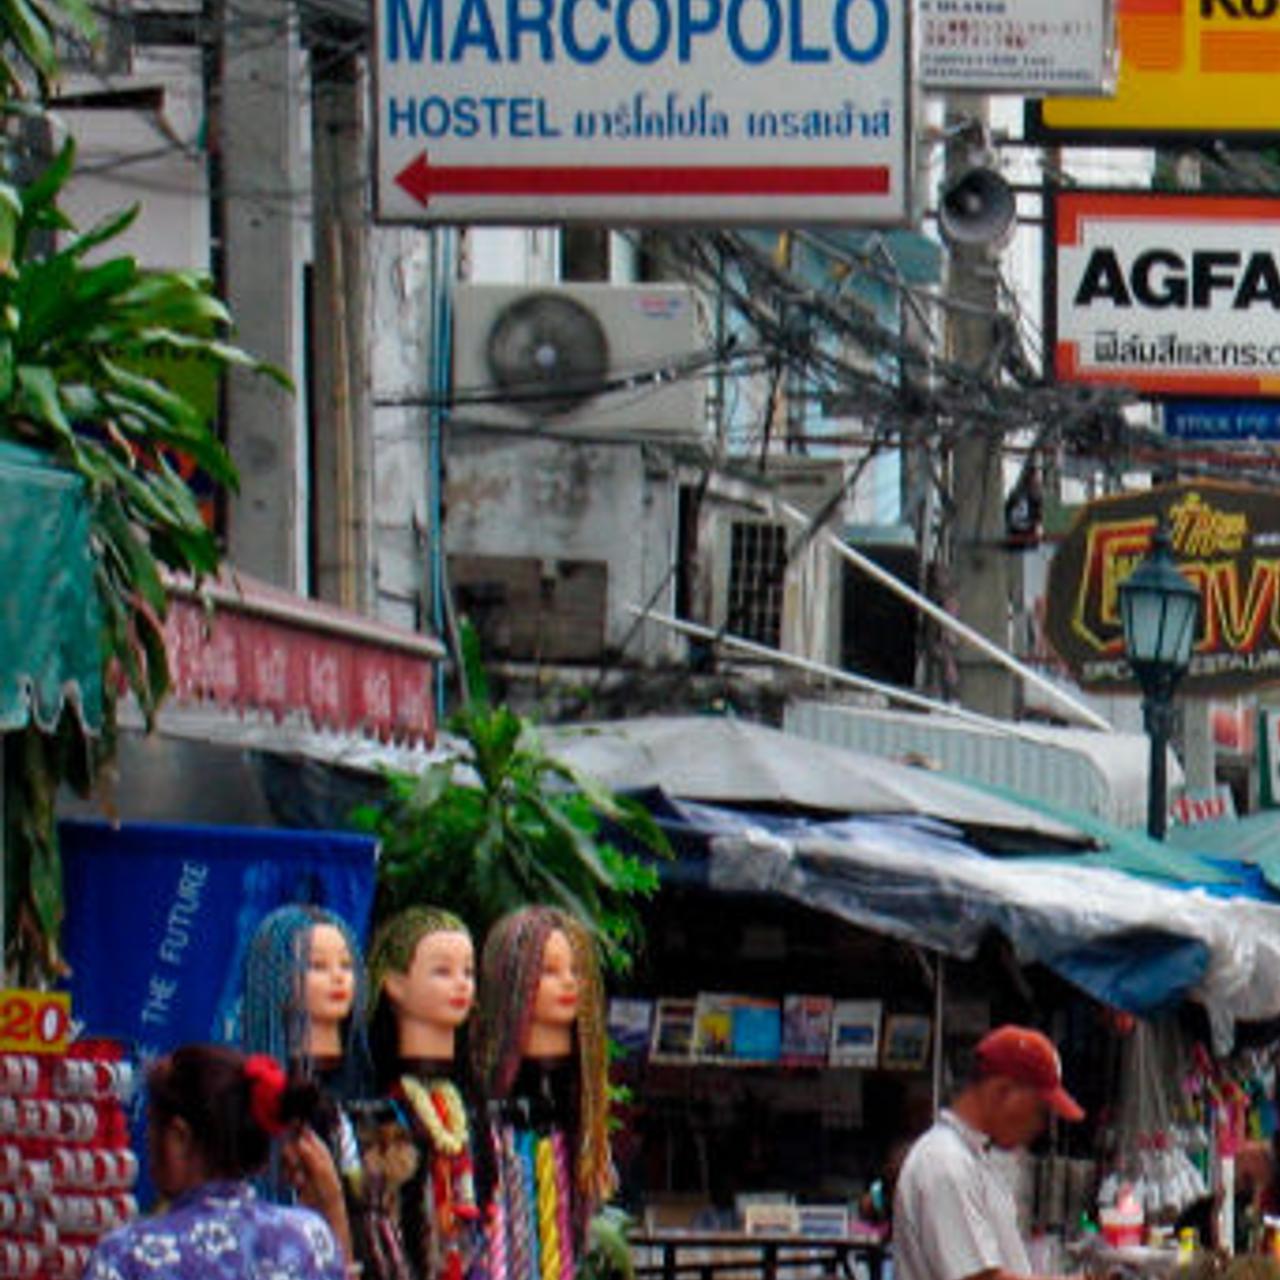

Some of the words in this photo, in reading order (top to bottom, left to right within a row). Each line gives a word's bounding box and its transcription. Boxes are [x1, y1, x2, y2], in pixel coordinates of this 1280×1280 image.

[387, 0, 891, 64] MARCOPOLO
[388, 97, 561, 139] HOSTEL
[160, 860, 212, 968] FUTURE
[141, 975, 180, 1028] THE
